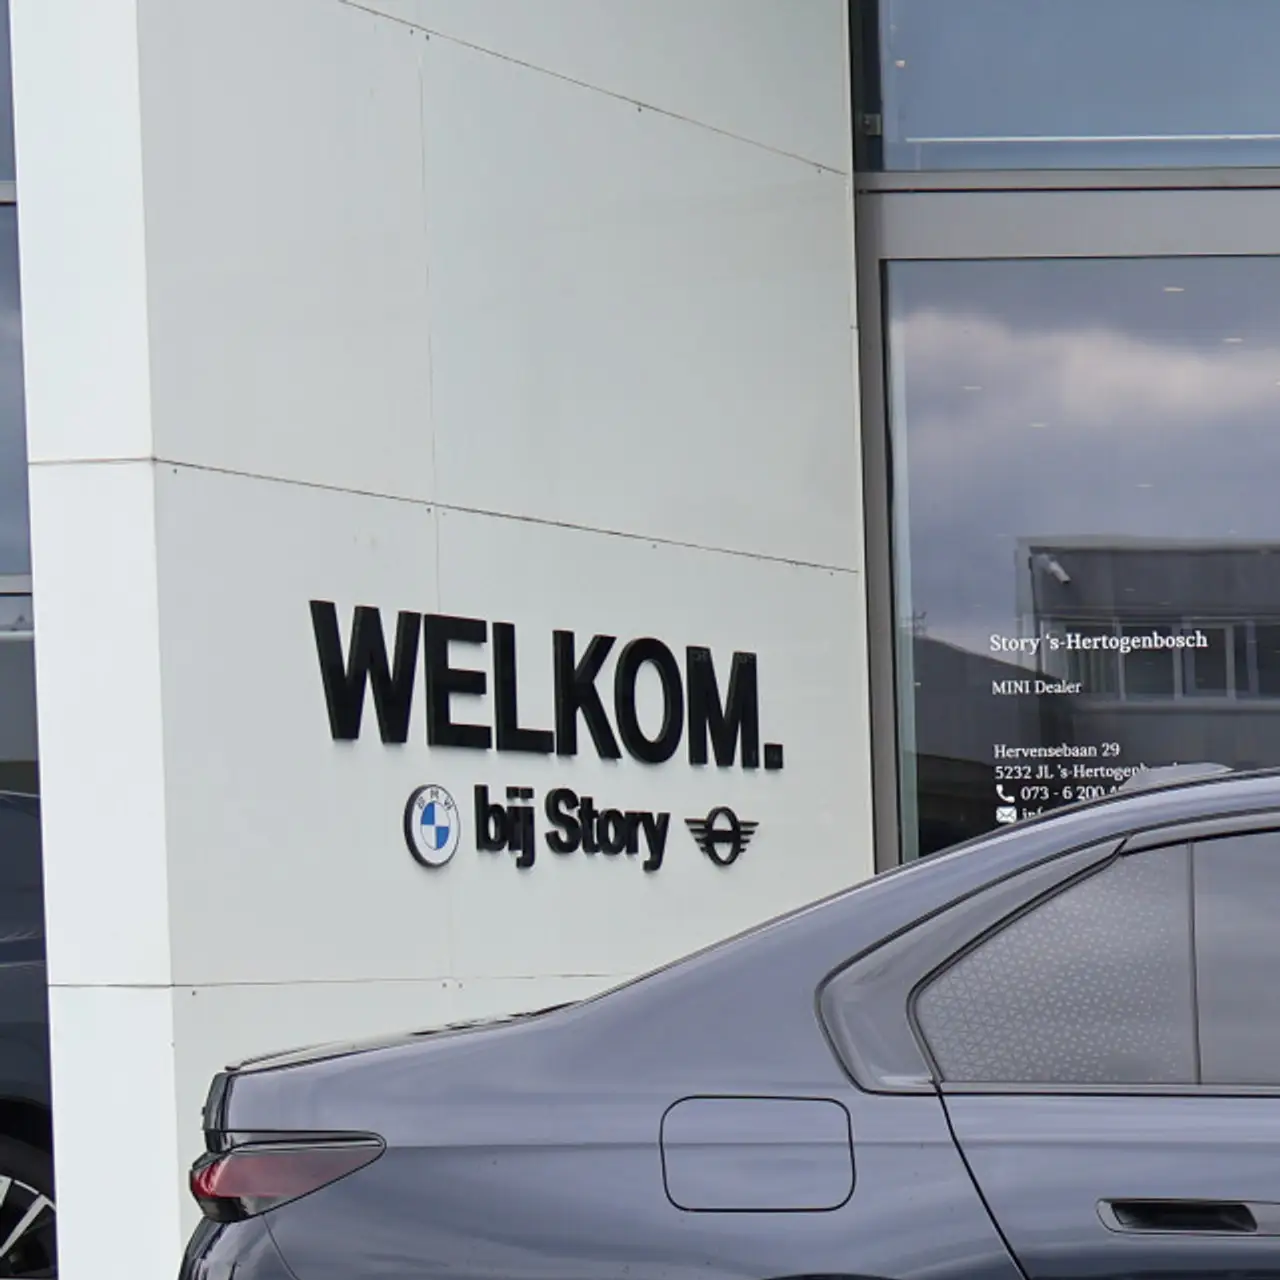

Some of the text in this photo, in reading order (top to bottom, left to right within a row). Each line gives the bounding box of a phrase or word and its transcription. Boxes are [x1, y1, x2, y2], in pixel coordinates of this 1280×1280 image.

[989, 634, 1041, 655] Story
[309, 599, 784, 770] WELKOM.
[991, 680, 1082, 695] MINI Dealer
[993, 742, 1121, 759] Hervensebaan 29
[995, 765, 1032, 779] 5232
[1036, 764, 1055, 779] JL
[1020, 785, 1050, 801] 073
[1062, 785, 1073, 800] 6
[474, 784, 671, 873] bij Story
